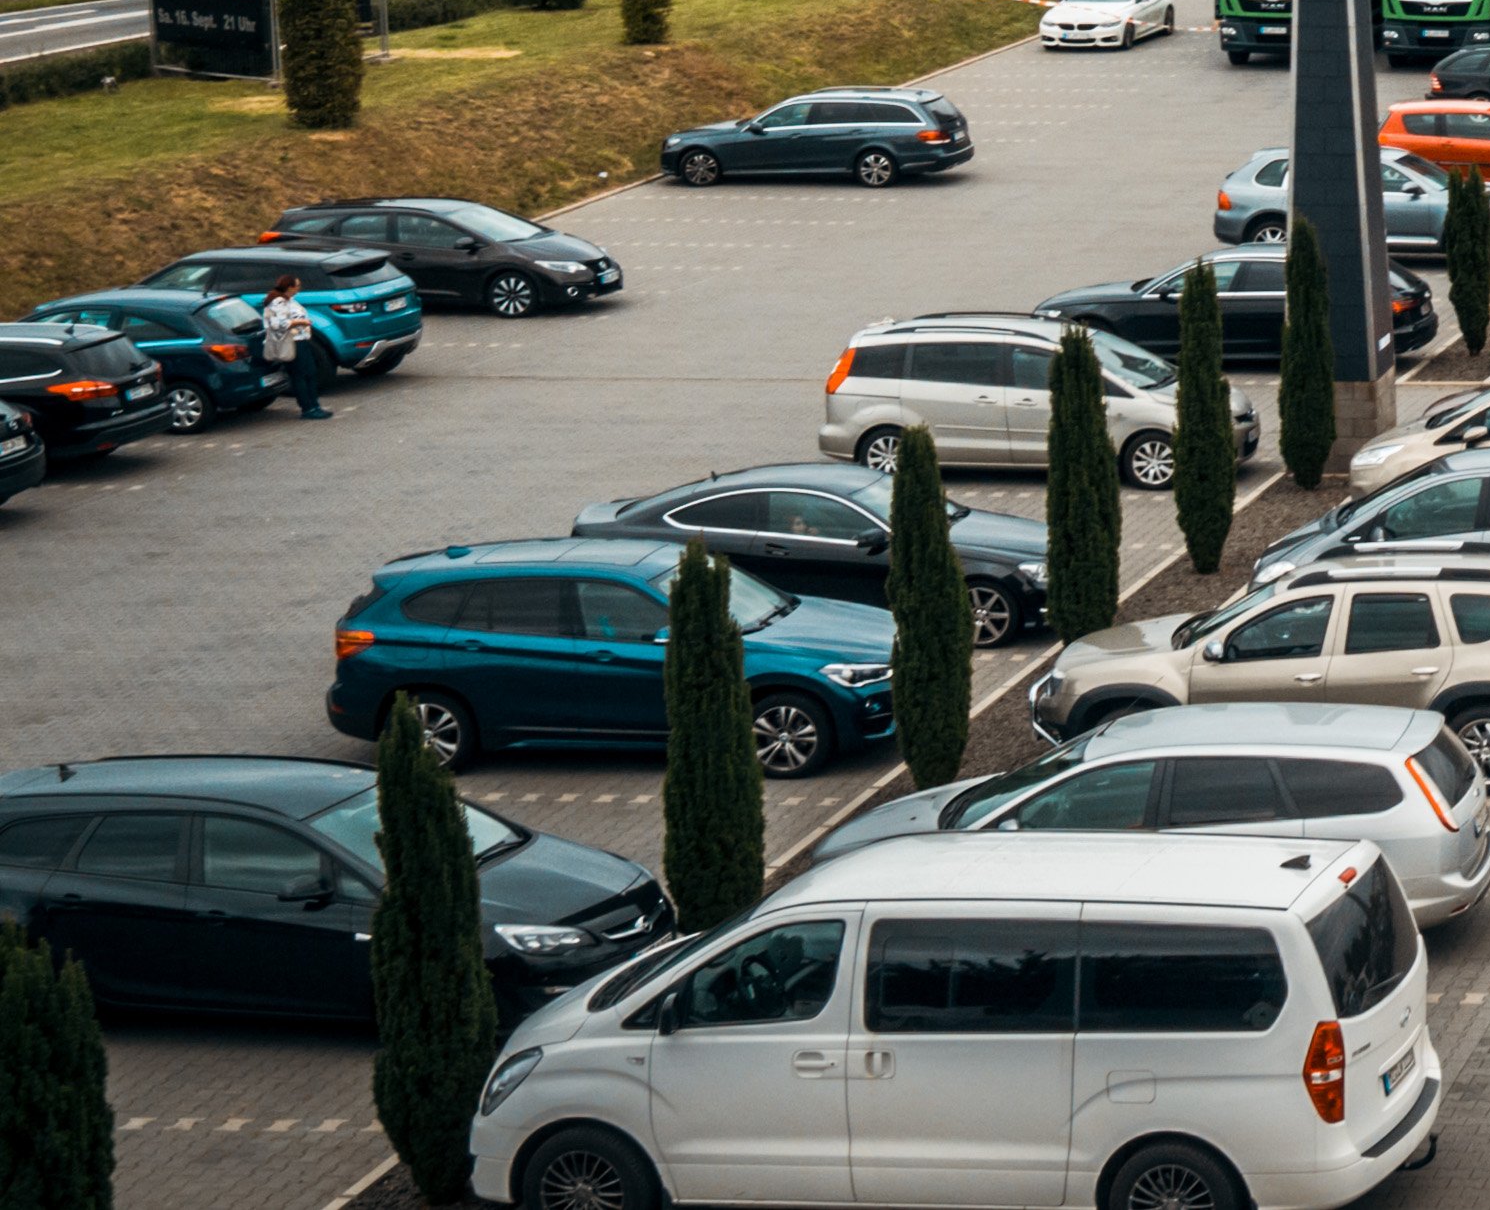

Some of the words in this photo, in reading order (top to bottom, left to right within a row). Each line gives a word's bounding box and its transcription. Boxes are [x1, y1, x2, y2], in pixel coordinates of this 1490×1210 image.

[158, 7, 173, 25] Sa.
[175, 9, 190, 27] 16.
[191, 11, 217, 32] Sept.
[223, 14, 236, 31] 21
[238, 15, 256, 33] Uhr
